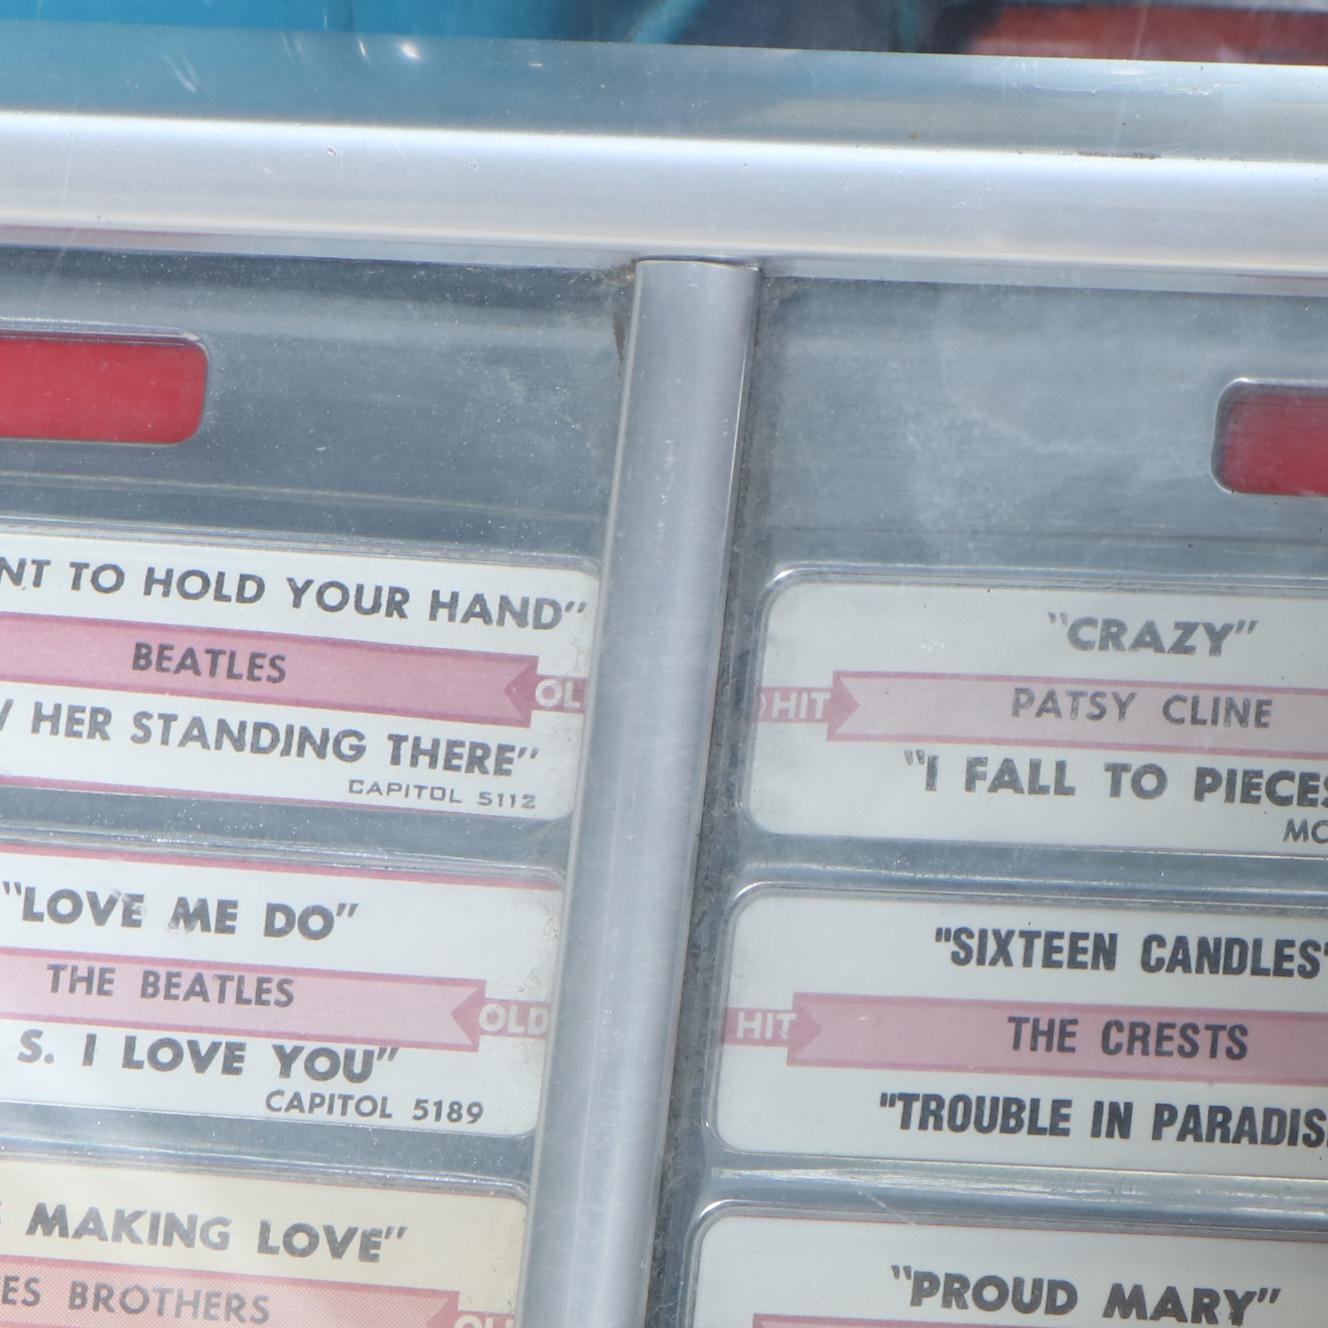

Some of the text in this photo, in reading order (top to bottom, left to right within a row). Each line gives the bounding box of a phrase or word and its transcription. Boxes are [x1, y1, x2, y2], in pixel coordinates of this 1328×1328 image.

[1048, 612, 1258, 656] "CRAZY"
[132, 642, 287, 684] BEATLES
[1011, 688, 1274, 728] PATSY CLINE
[348, 778, 537, 810] CAPITOL 5112
[3, 881, 359, 940] "LOVE ME DO"
[934, 926, 1120, 971] "SIXTEEN
[46, 964, 296, 1008] THE BEATLES
[1008, 1016, 1250, 1062] THE CRESTS
[264, 1090, 484, 1124] CAPITOL 5189
[879, 1092, 1072, 1137] "TROUBLE
[1091, 1101, 1134, 1140] IN
[26, 1203, 230, 1250] MAKING
[256, 1220, 408, 1262] LOVE"
[68, 1282, 271, 1325] BROTHERS
[892, 1264, 1280, 1327] "PROUD MARY"
